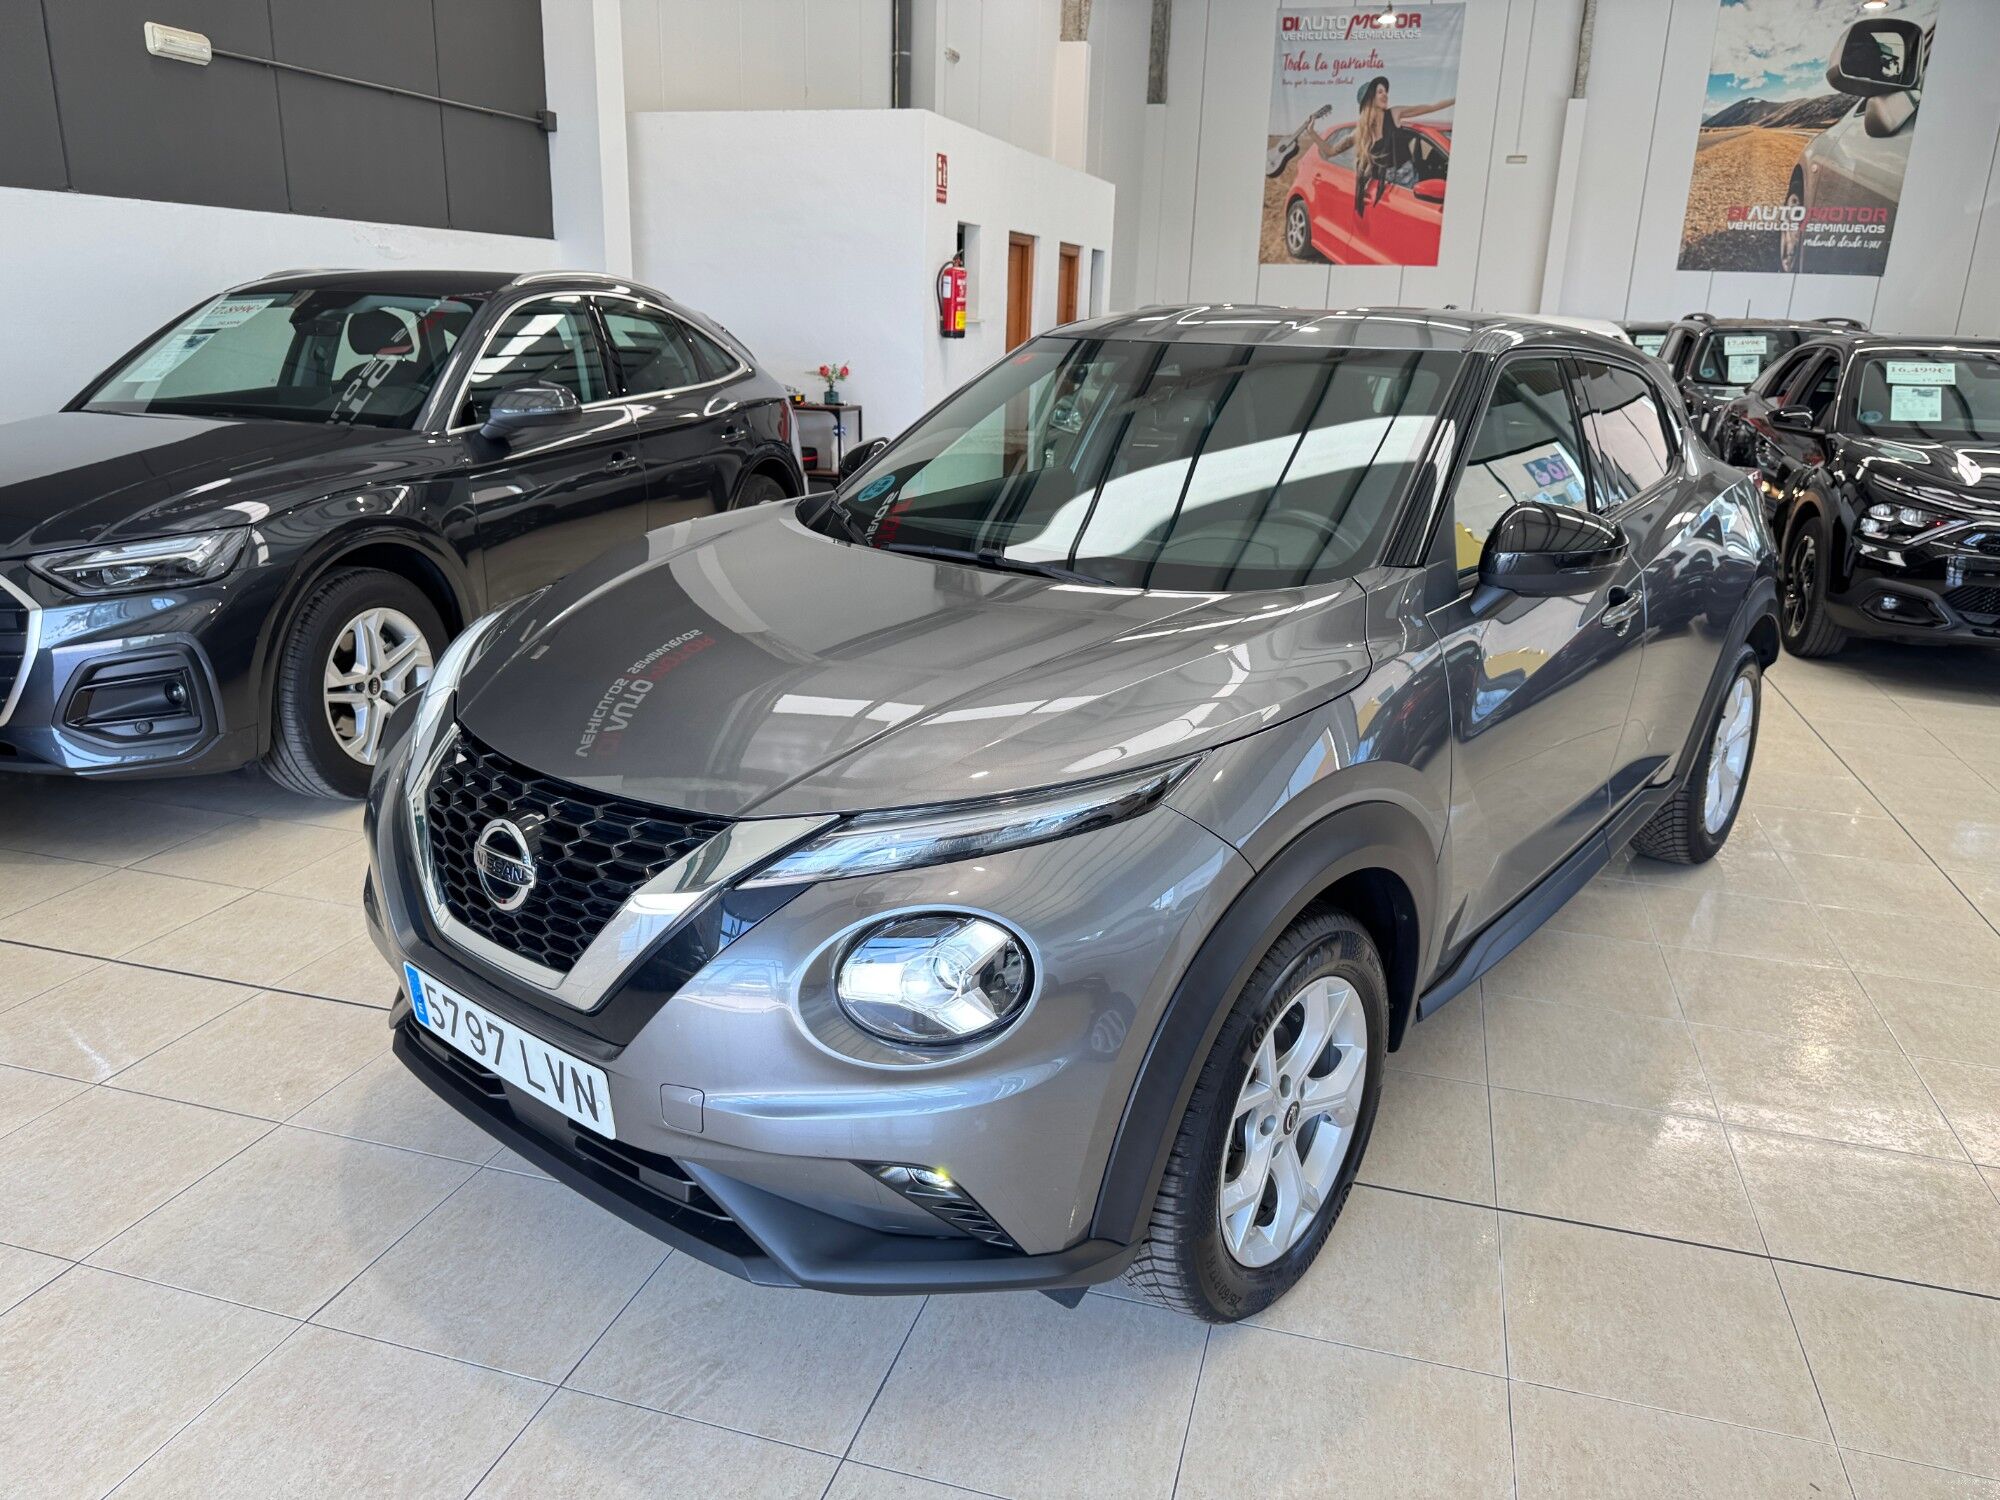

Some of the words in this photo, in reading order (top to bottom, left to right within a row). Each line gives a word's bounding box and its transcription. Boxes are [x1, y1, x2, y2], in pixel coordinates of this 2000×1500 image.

[1283, 50, 1311, 71] Toda
[1314, 52, 1328, 71] la
[1805, 223, 1886, 234] SEMINUEVOS
[417, 1002, 425, 1015] E
[424, 983, 505, 1066] 5797
[519, 1039, 599, 1122] LVN
